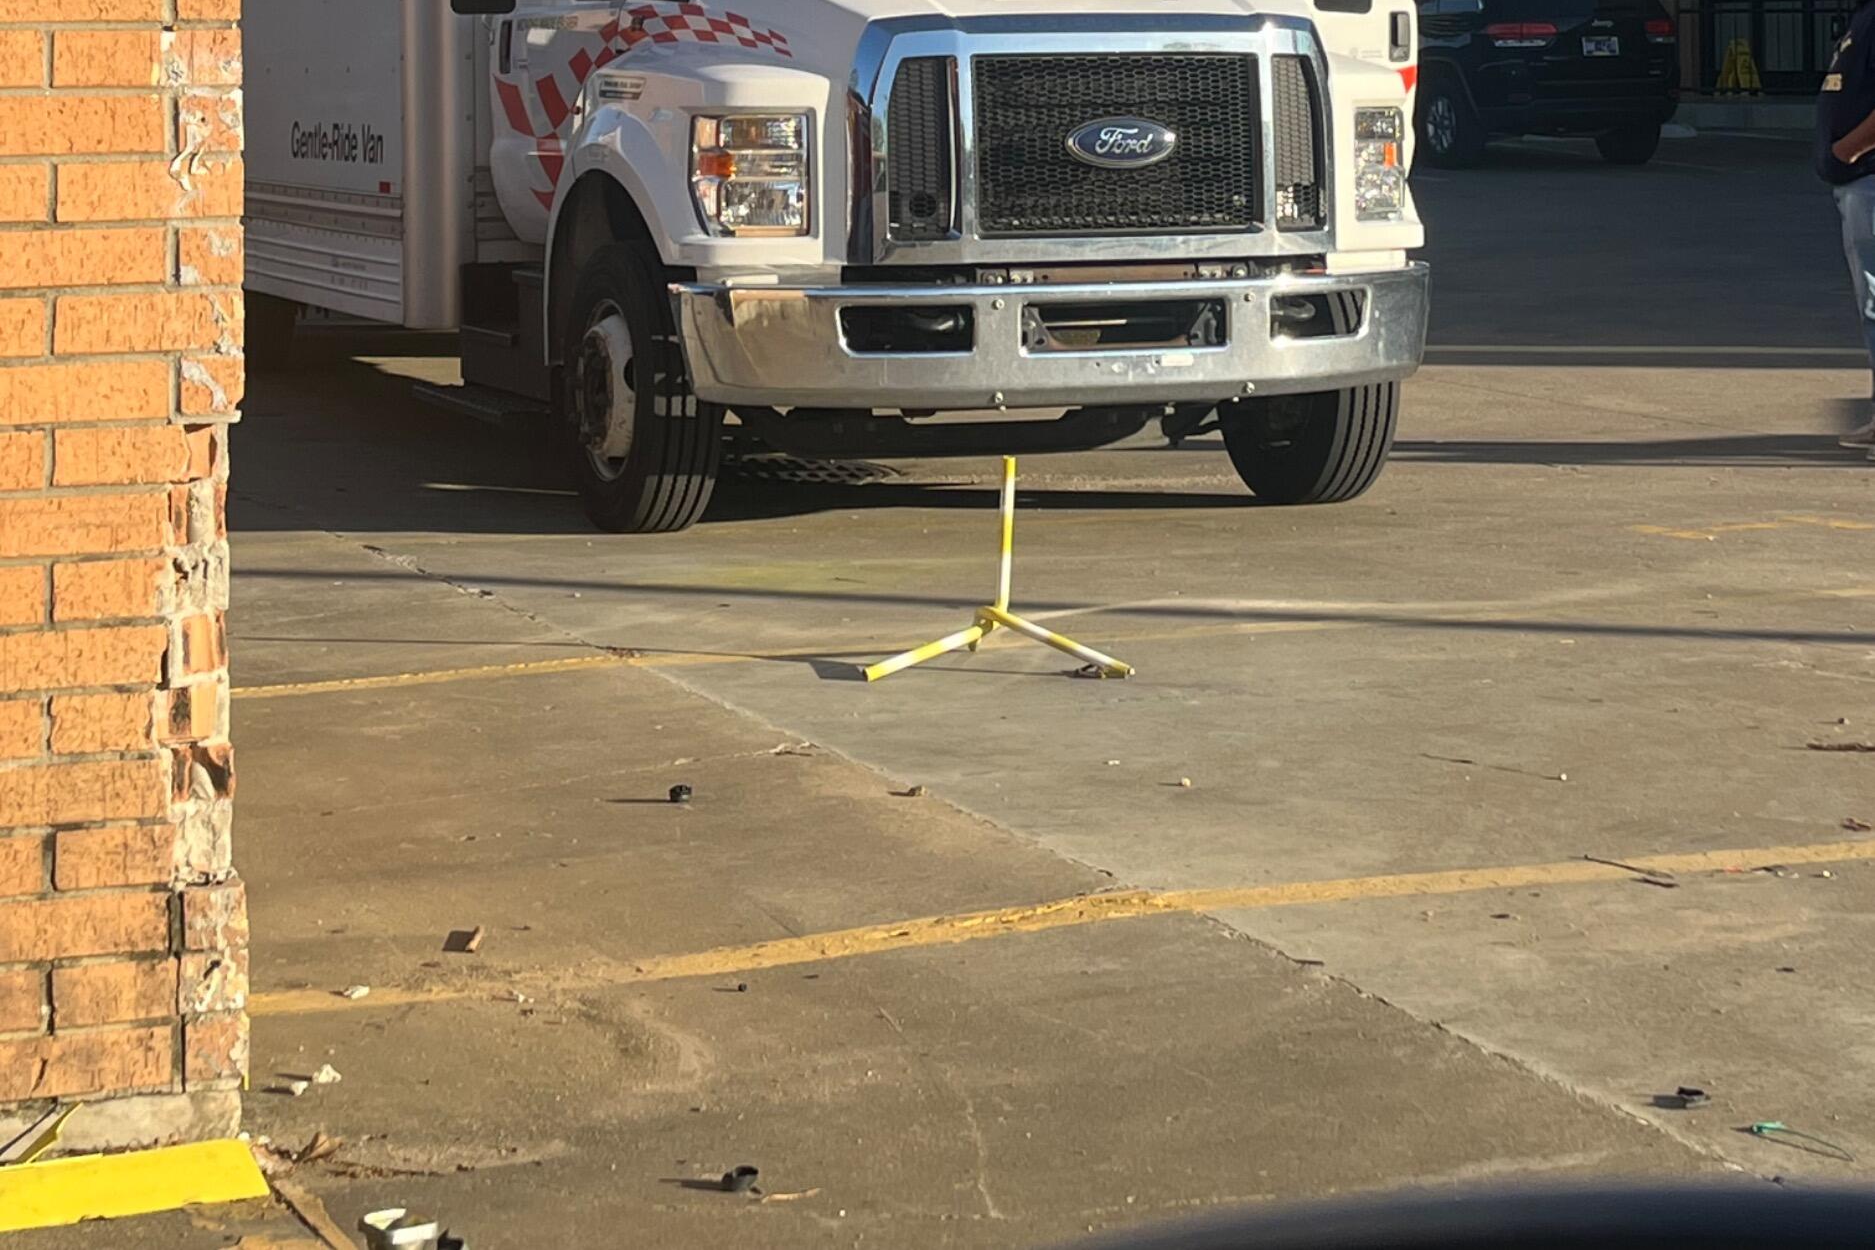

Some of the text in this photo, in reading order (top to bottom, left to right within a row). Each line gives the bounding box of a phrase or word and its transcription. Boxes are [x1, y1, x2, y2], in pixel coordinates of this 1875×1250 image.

[291, 121, 384, 164] Gentle-Ride Van
[1095, 126, 1155, 154] Ford
